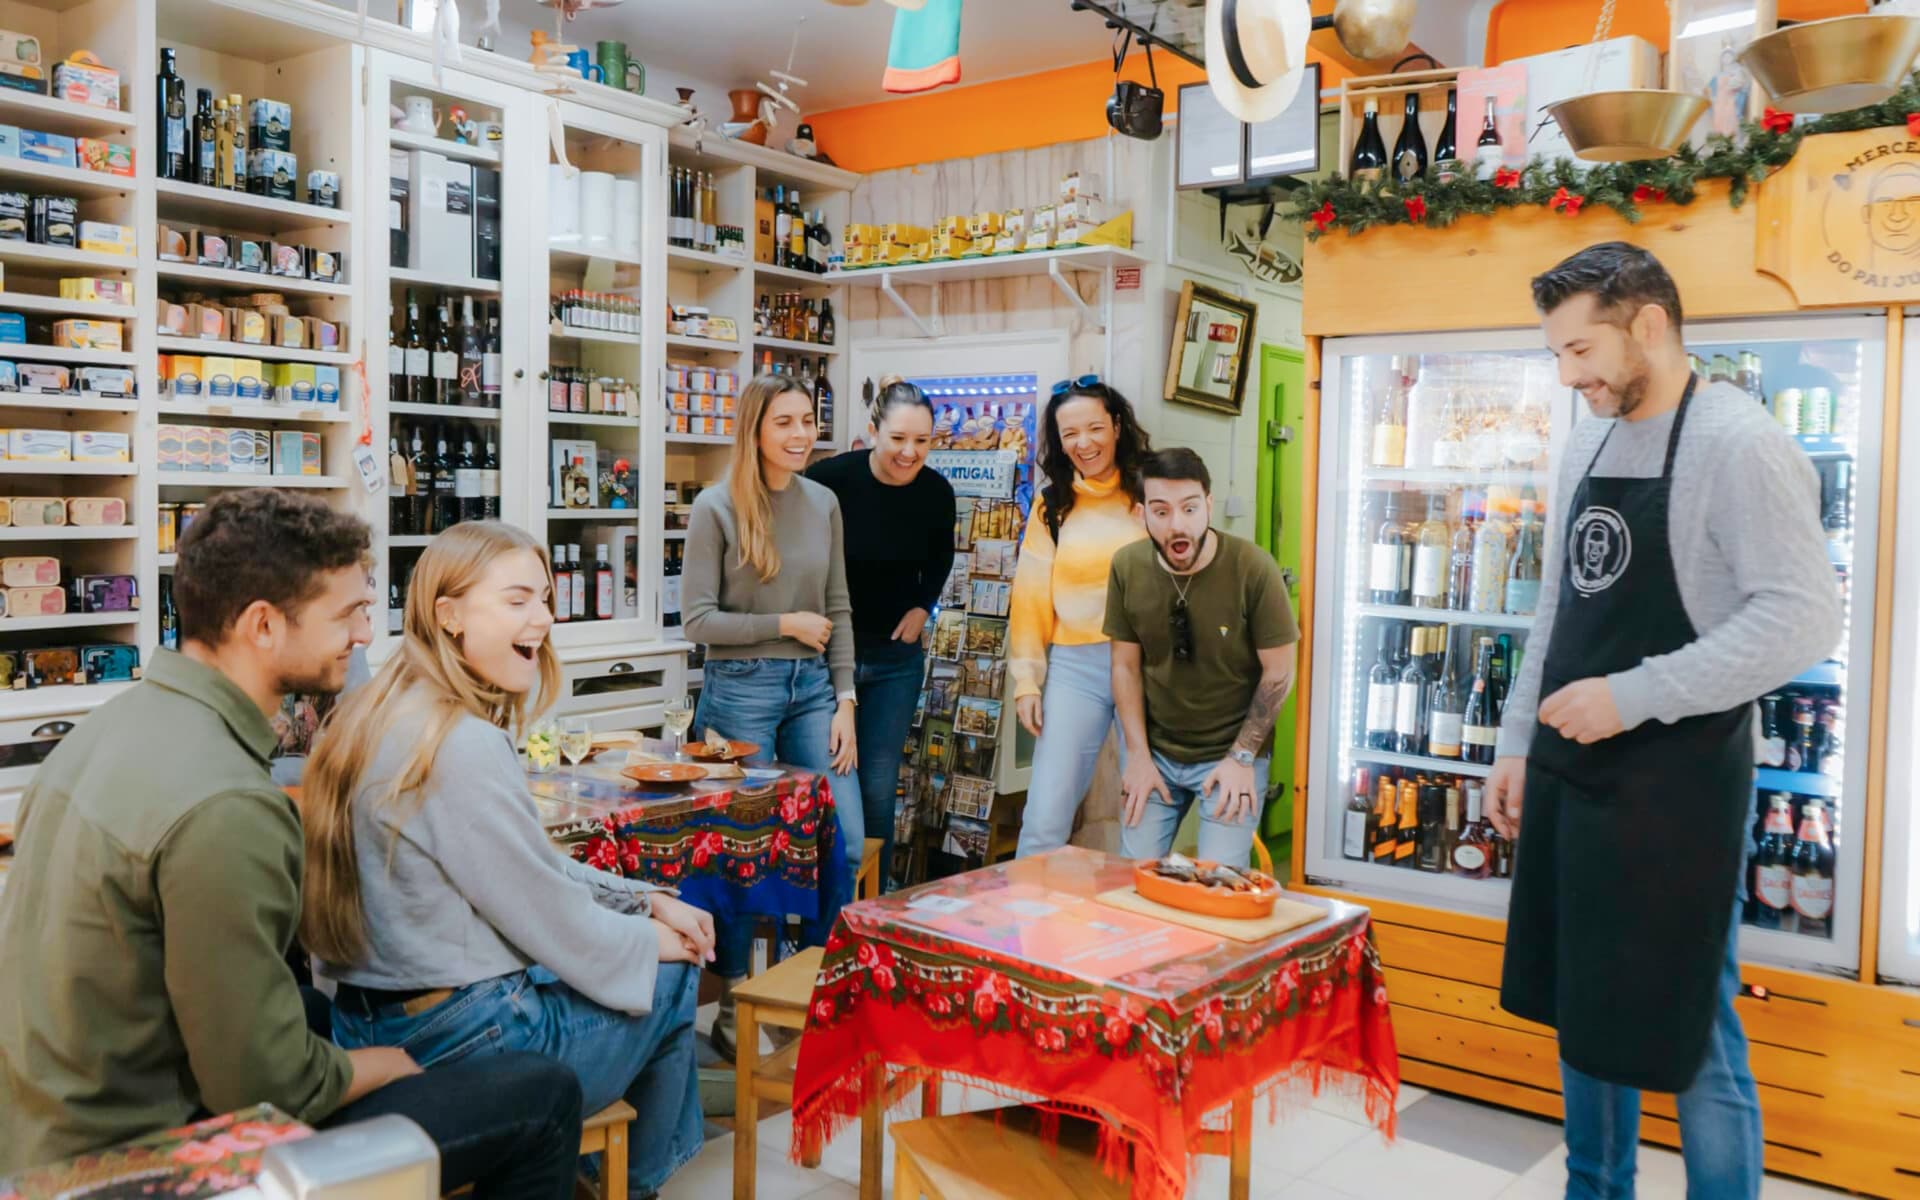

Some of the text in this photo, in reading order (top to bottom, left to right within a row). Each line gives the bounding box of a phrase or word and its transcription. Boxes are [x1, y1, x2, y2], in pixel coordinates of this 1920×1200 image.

[1845, 141, 1920, 172] MERCE
[1827, 250, 1852, 273] DO
[1853, 269, 1889, 287] PAI
